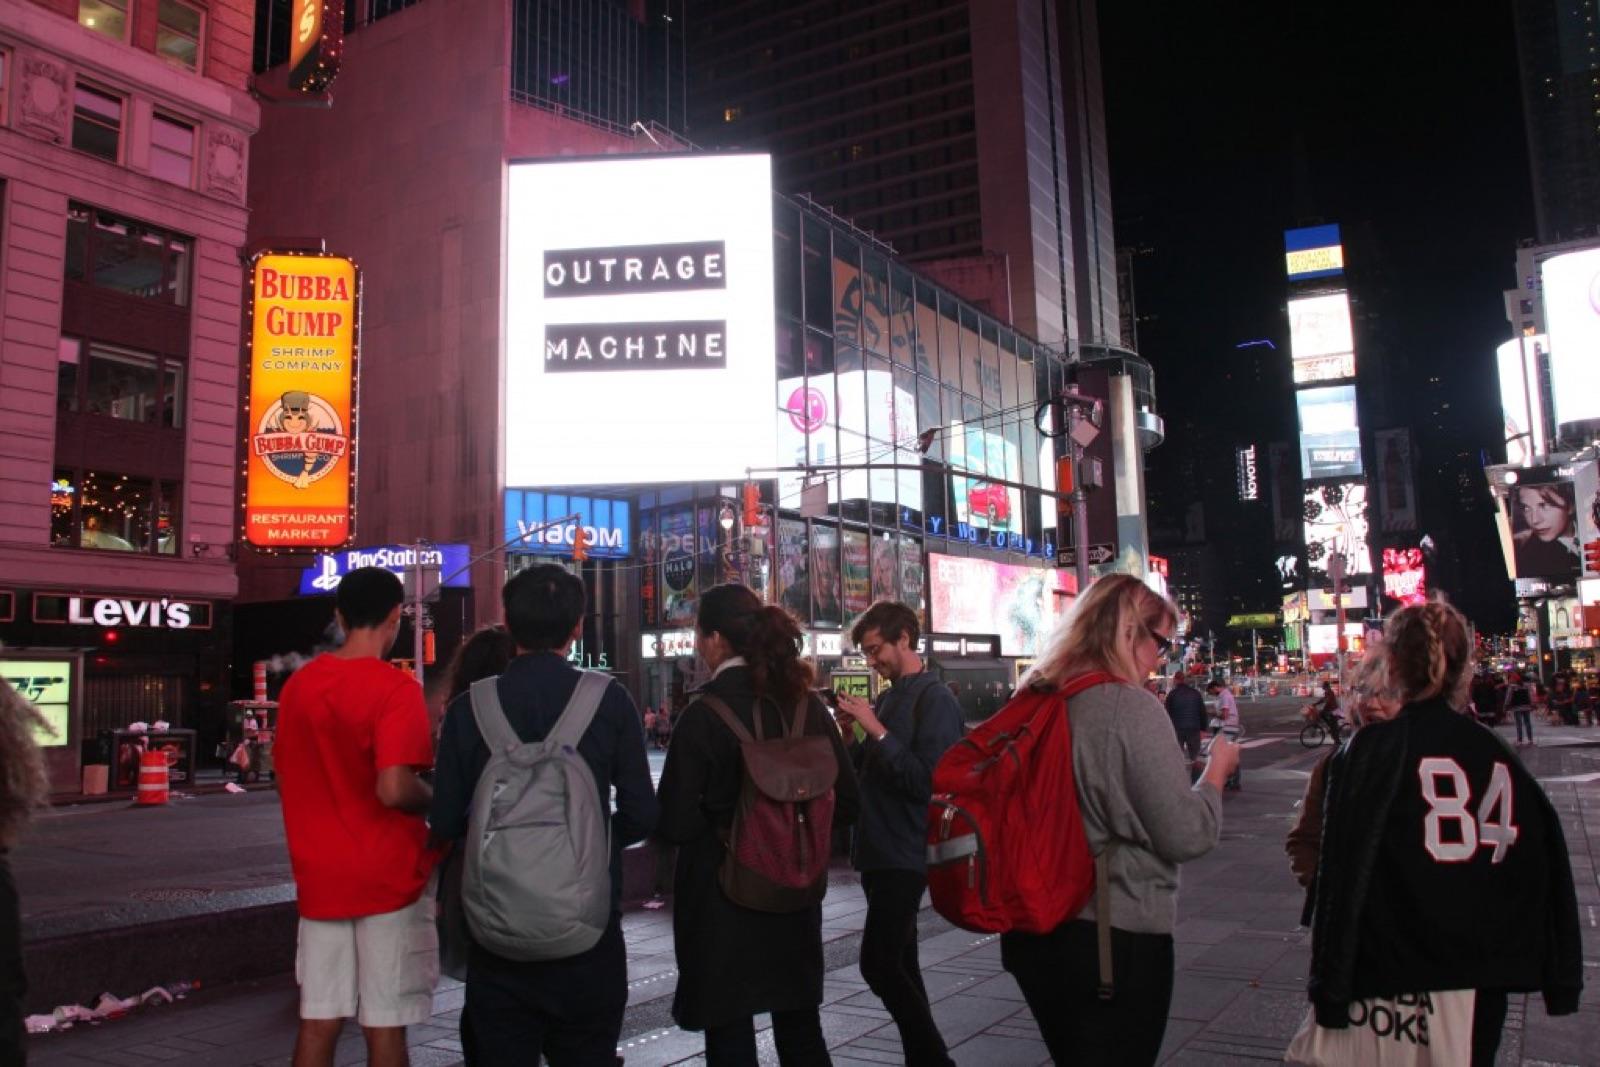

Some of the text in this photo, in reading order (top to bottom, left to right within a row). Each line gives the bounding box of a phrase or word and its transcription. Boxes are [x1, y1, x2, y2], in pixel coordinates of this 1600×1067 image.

[546, 253, 723, 287] OUTRAGE
[261, 268, 350, 301] BUBBA
[266, 305, 343, 337] GUMP
[271, 347, 336, 357] SHRIMP
[546, 332, 723, 360] MACHINE
[262, 360, 345, 370] COMPANY
[256, 432, 345, 452] BUBBA GUMP
[271, 452, 304, 462] SHRIMP
[1246, 444, 1257, 499] NOVOTEL
[251, 513, 346, 525] RESTAURANT
[267, 527, 331, 540] MARKET
[68, 597, 191, 629] Levi's
[1418, 757, 1518, 864] 84
